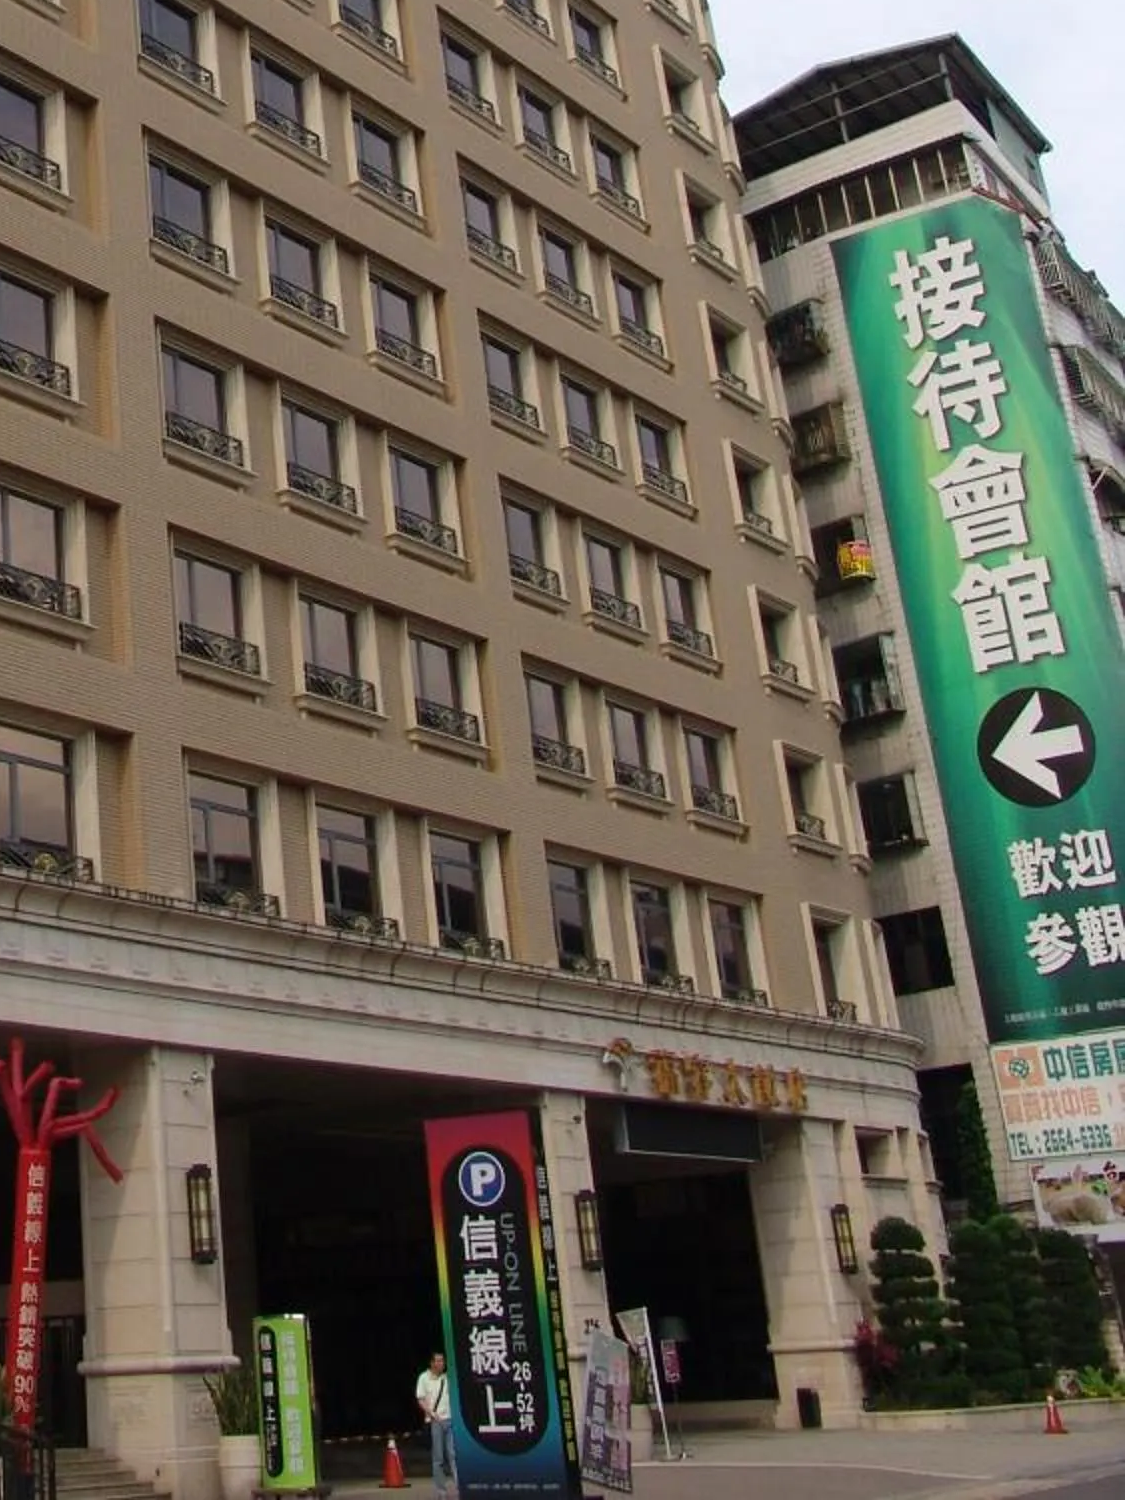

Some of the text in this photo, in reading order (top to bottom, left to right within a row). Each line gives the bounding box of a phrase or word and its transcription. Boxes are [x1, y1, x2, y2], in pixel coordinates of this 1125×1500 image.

[888, 236, 1066, 673] 接待會館
[1007, 829, 1116, 898] 歡迎
[1025, 903, 1125, 975] 參觀
[470, 1163, 496, 1196] P
[459, 1214, 516, 1433] 信義線上
[508, 1303, 527, 1353] LINE
